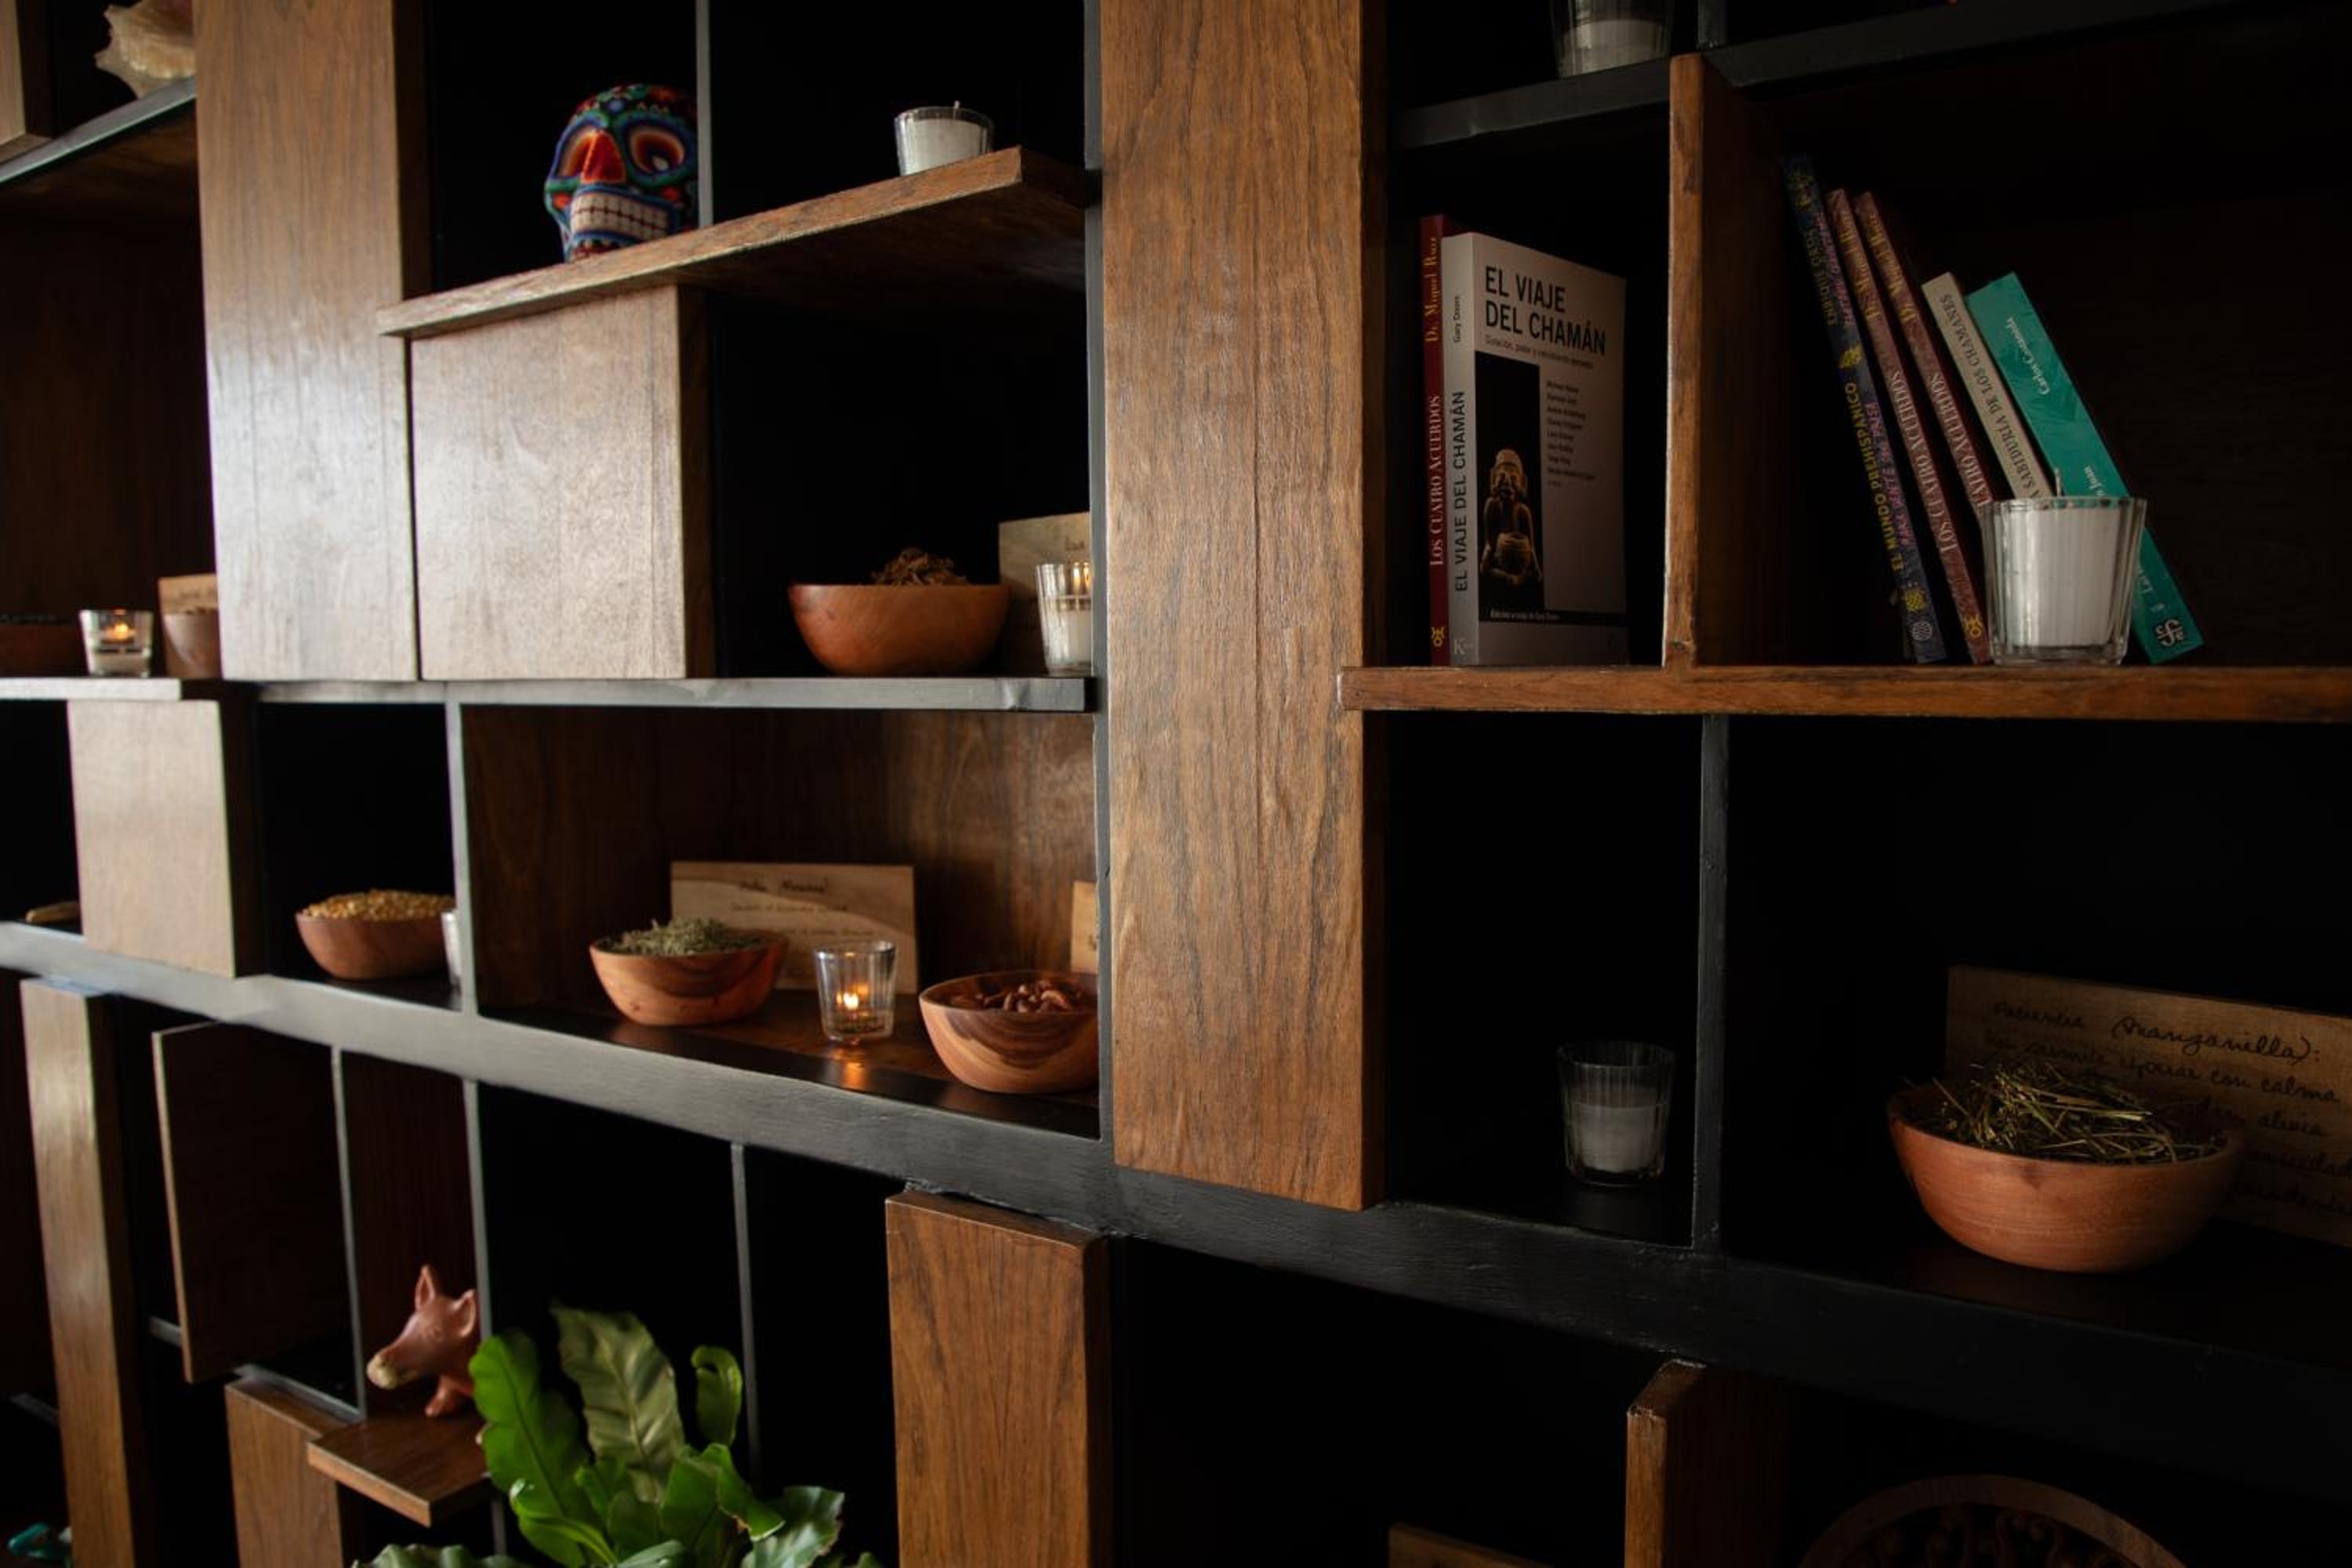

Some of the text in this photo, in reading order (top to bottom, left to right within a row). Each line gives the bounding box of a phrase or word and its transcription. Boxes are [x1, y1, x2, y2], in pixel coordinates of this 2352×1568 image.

[1486, 267, 1566, 313] EL VIAJE
[1486, 300, 1523, 335] DEL
[1529, 312, 1606, 356] CHAMÁN
[1940, 294, 1980, 367] CHAMANES
[1973, 367, 1993, 394] LOS
[1986, 395, 2004, 412] DE
[1892, 371, 1958, 552] LOS CUATRO ACUERDOS
[1931, 372, 1990, 507] UATRO ACUERDOS
[1995, 412, 2037, 489] SABIDURÍA
[1428, 394, 1444, 566] LOS CUATRO ACUERDOS
[1450, 391, 1468, 592] EL VIAJE DEL CHAMÁN
[1874, 492, 1899, 550] MUNDO
[1888, 553, 1905, 573] EL
[2210, 1068, 2253, 1089] con
[2260, 1076, 2341, 1103] calma
